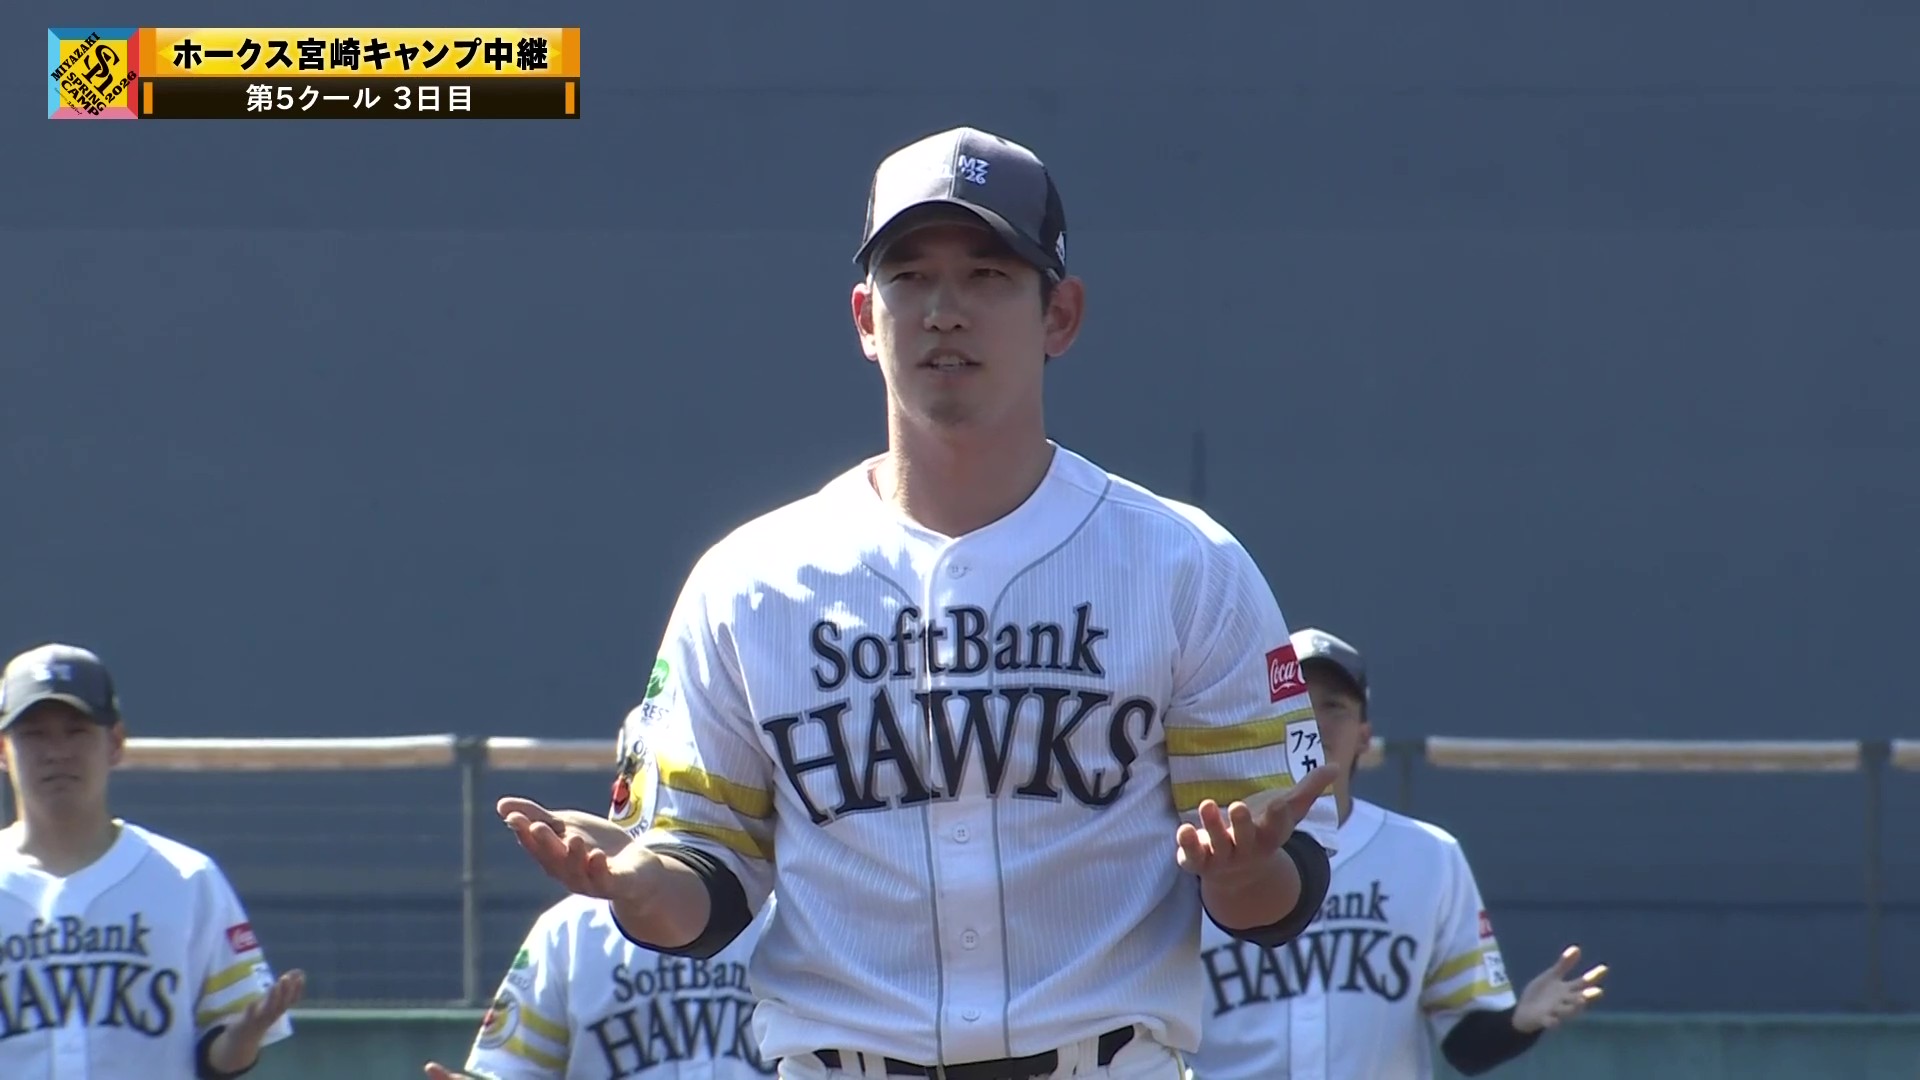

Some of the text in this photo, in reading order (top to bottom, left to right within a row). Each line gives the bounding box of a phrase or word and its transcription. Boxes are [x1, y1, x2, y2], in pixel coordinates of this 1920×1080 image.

[958, 154, 990, 173] MZ
[809, 602, 1109, 692] SoftBank
[761, 686, 1158, 827] HAWKS
[1290, 729, 1321, 753] ファ
[0, 912, 151, 962] oftBank
[612, 953, 752, 1002] SoftBan
[1201, 928, 1419, 1019] HAWKS
[586, 997, 780, 1080] HAWK
